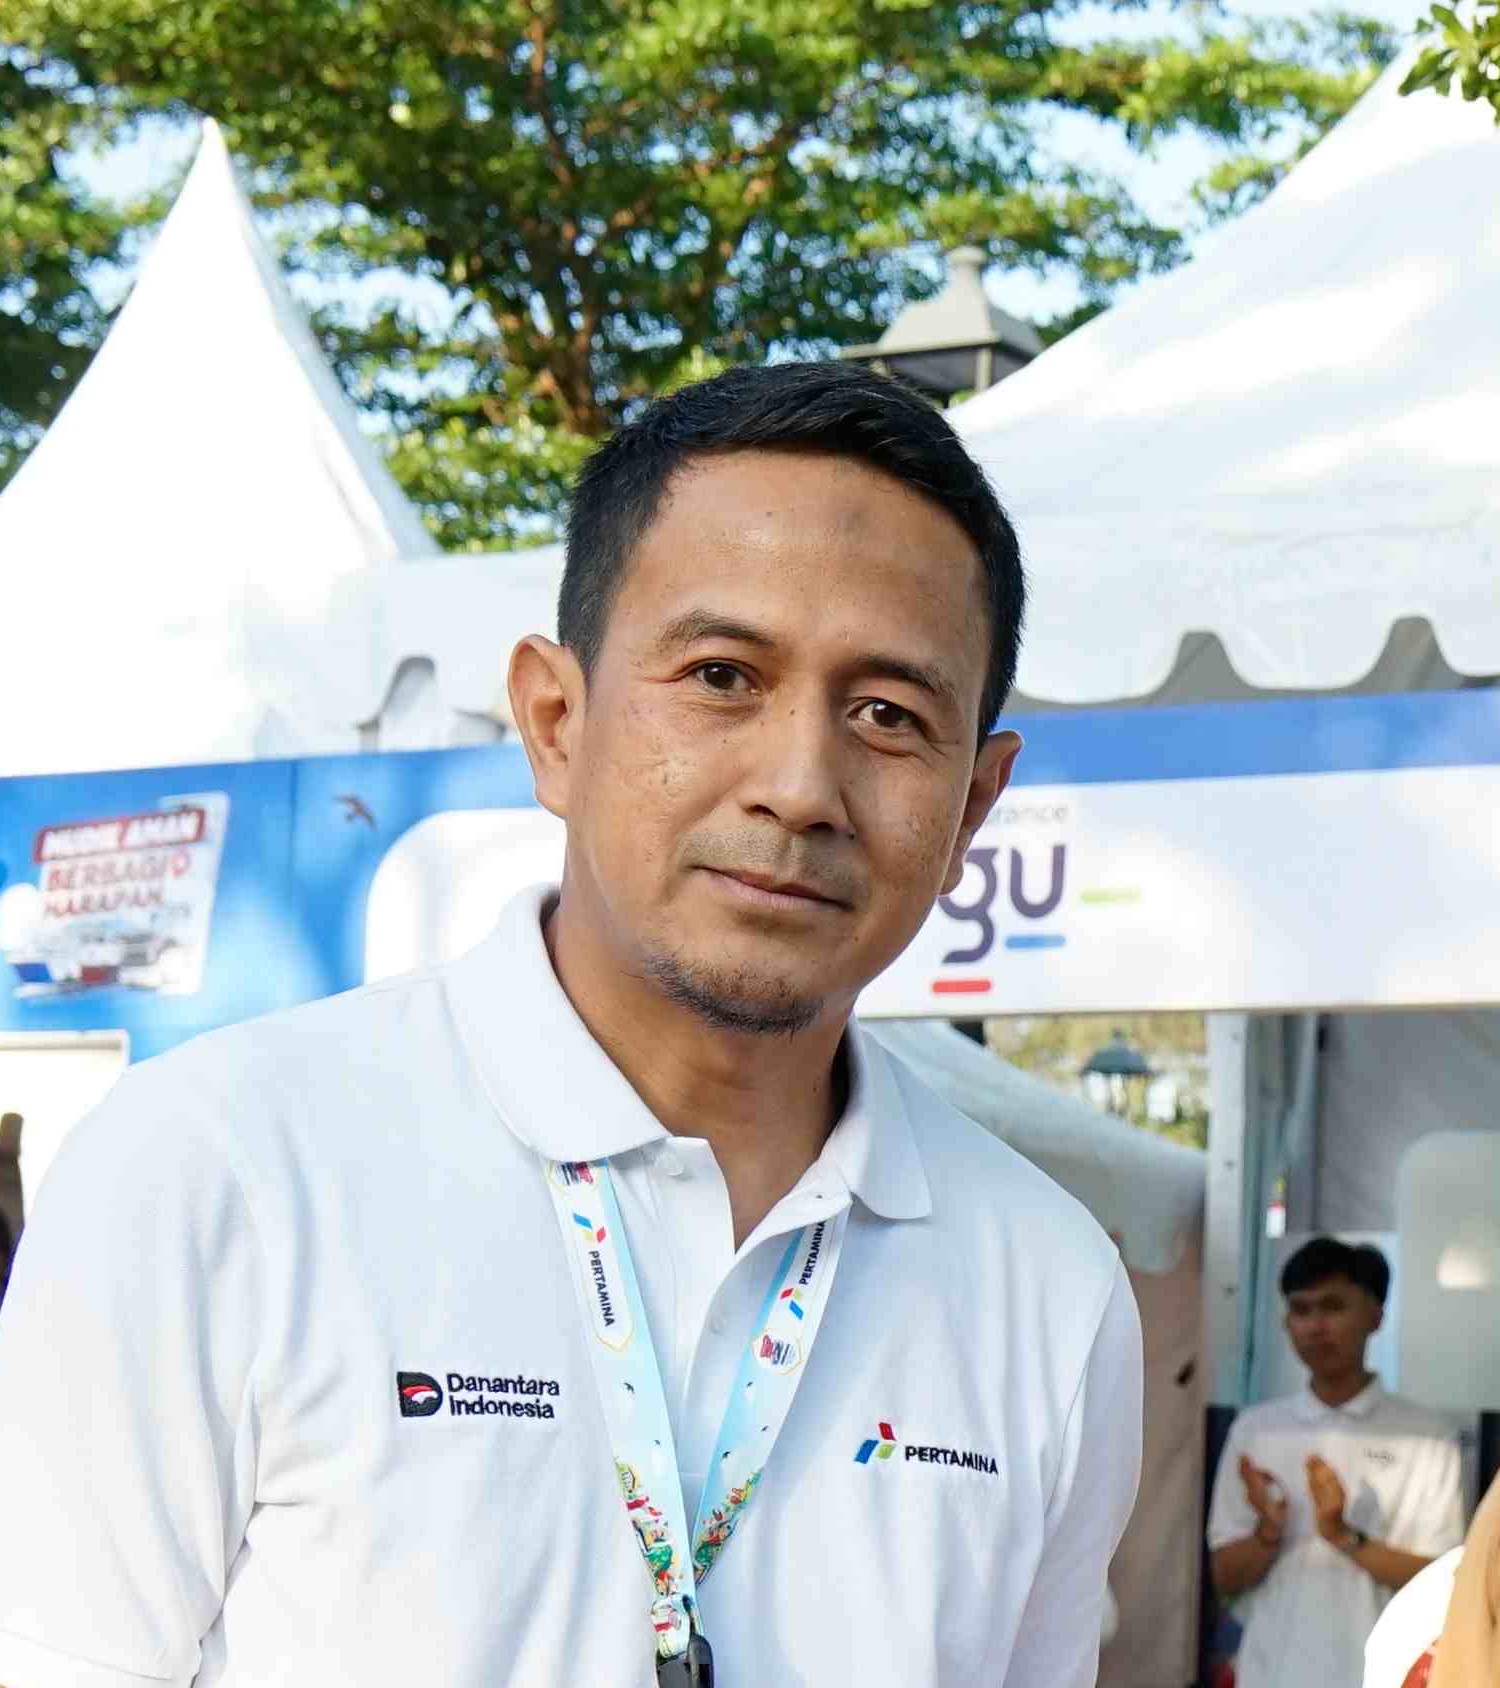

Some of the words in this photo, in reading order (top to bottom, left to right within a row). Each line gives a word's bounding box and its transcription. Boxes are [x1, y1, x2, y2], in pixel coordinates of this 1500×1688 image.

[798, 1219, 826, 1285] PERTAMINA
[589, 1251, 615, 1327] PERTAMINA
[447, 1373, 560, 1396] Danantara
[449, 1396, 555, 1419] Indonesia
[905, 1446, 999, 1474] PERTAMINA
